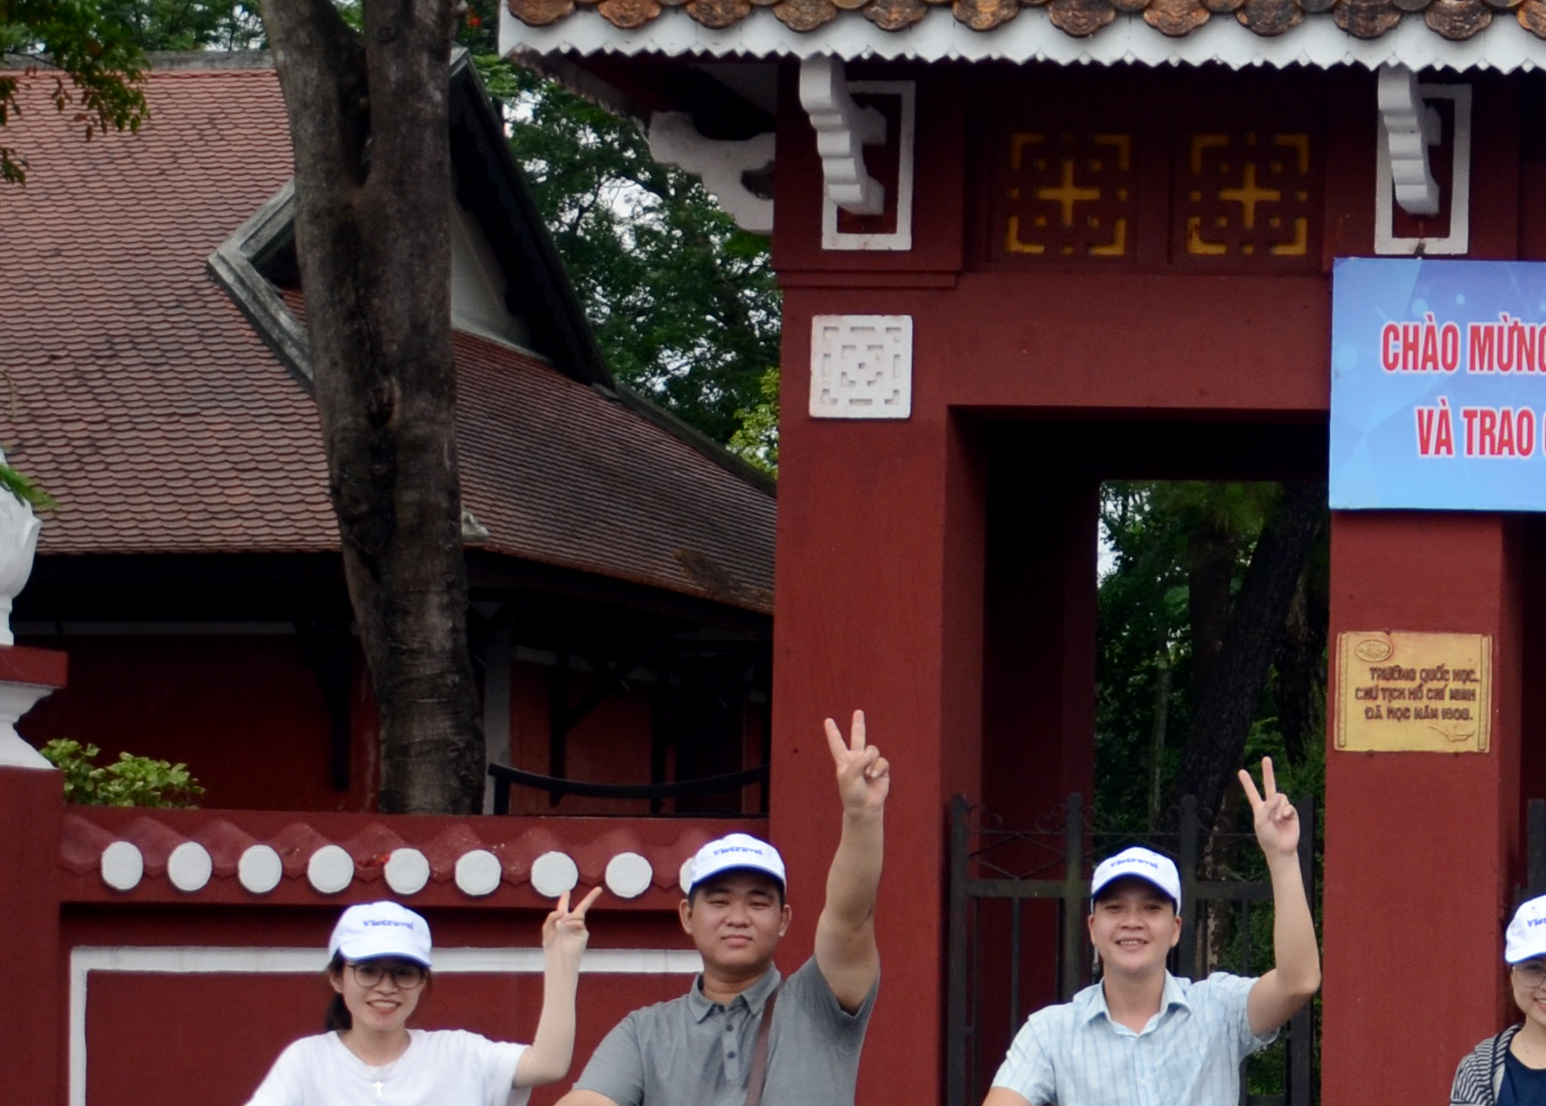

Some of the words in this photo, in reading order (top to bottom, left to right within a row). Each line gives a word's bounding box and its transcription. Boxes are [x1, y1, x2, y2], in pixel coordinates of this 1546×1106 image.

[1382, 314, 1458, 372] CHÀO
[1417, 397, 1453, 456] VÀ
[1463, 409, 1533, 456] TRAO
[1387, 707, 1410, 722] HỌC
